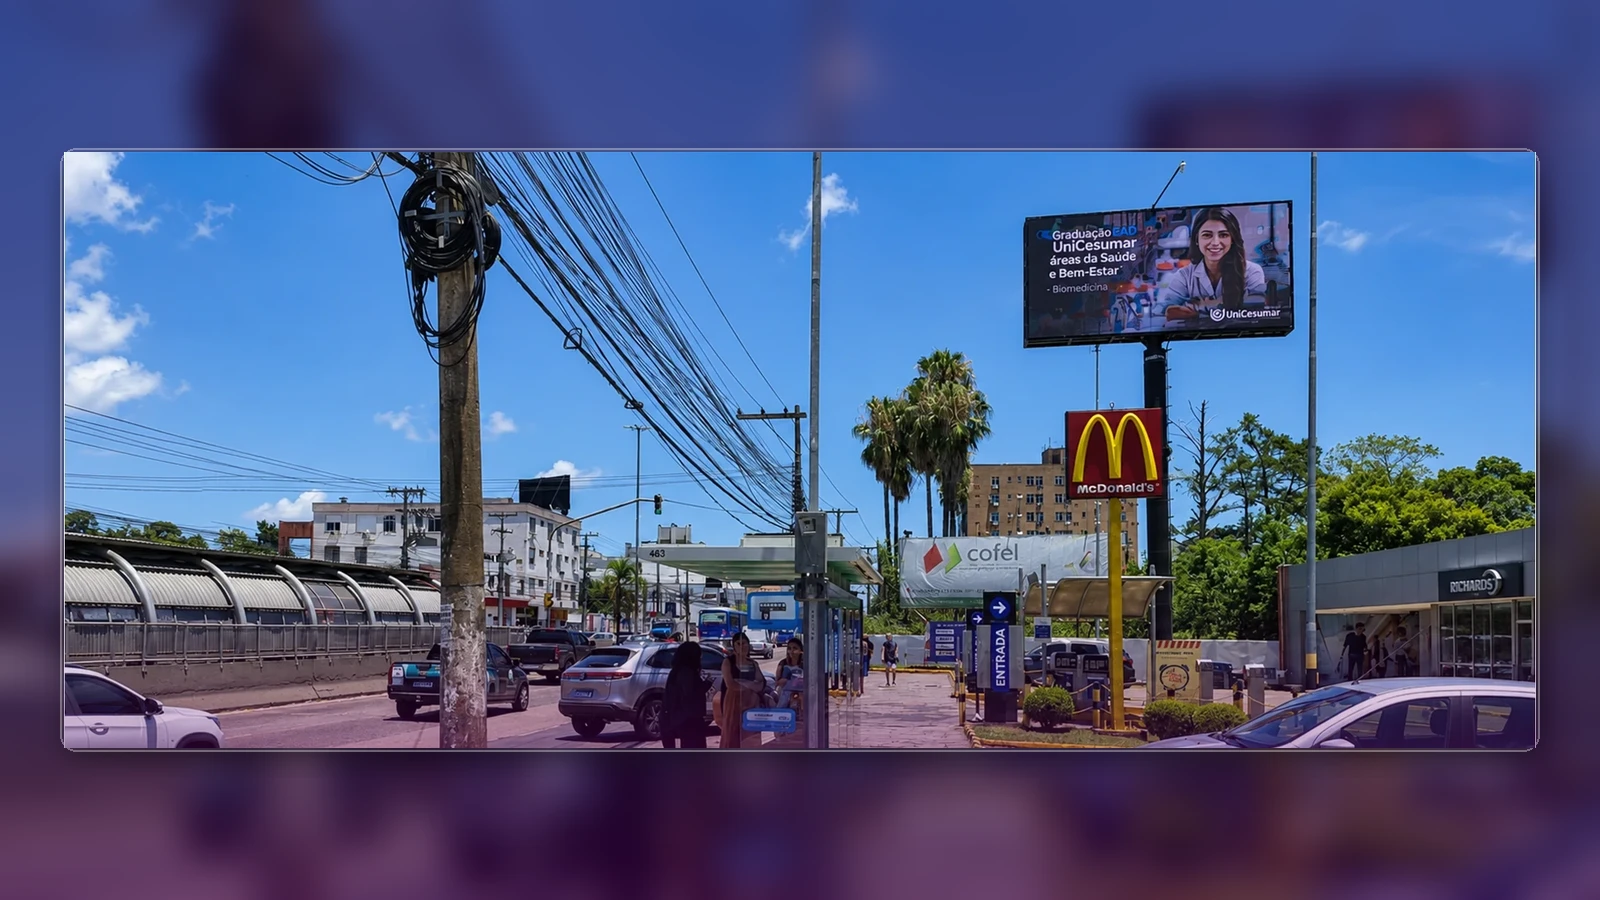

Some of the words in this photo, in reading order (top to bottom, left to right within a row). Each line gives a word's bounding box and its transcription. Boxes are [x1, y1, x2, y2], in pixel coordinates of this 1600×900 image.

[1052, 228, 1111, 240] Graduação
[1112, 226, 1137, 237] EAD
[1053, 239, 1137, 253] UniCesumar
[1050, 255, 1081, 266] áreas
[1083, 253, 1098, 264] da
[1100, 251, 1137, 263] Saúde
[1049, 271, 1057, 279] e
[1052, 282, 1109, 294] Biomedicina
[1226, 309, 1281, 319] UniCesumar
[1077, 482, 1155, 494] McDonald's
[649, 549, 665, 558] 463
[967, 543, 1018, 561] cofel
[1450, 579, 1493, 593] RICHARDS
[995, 628, 1006, 687] ENTRADA
